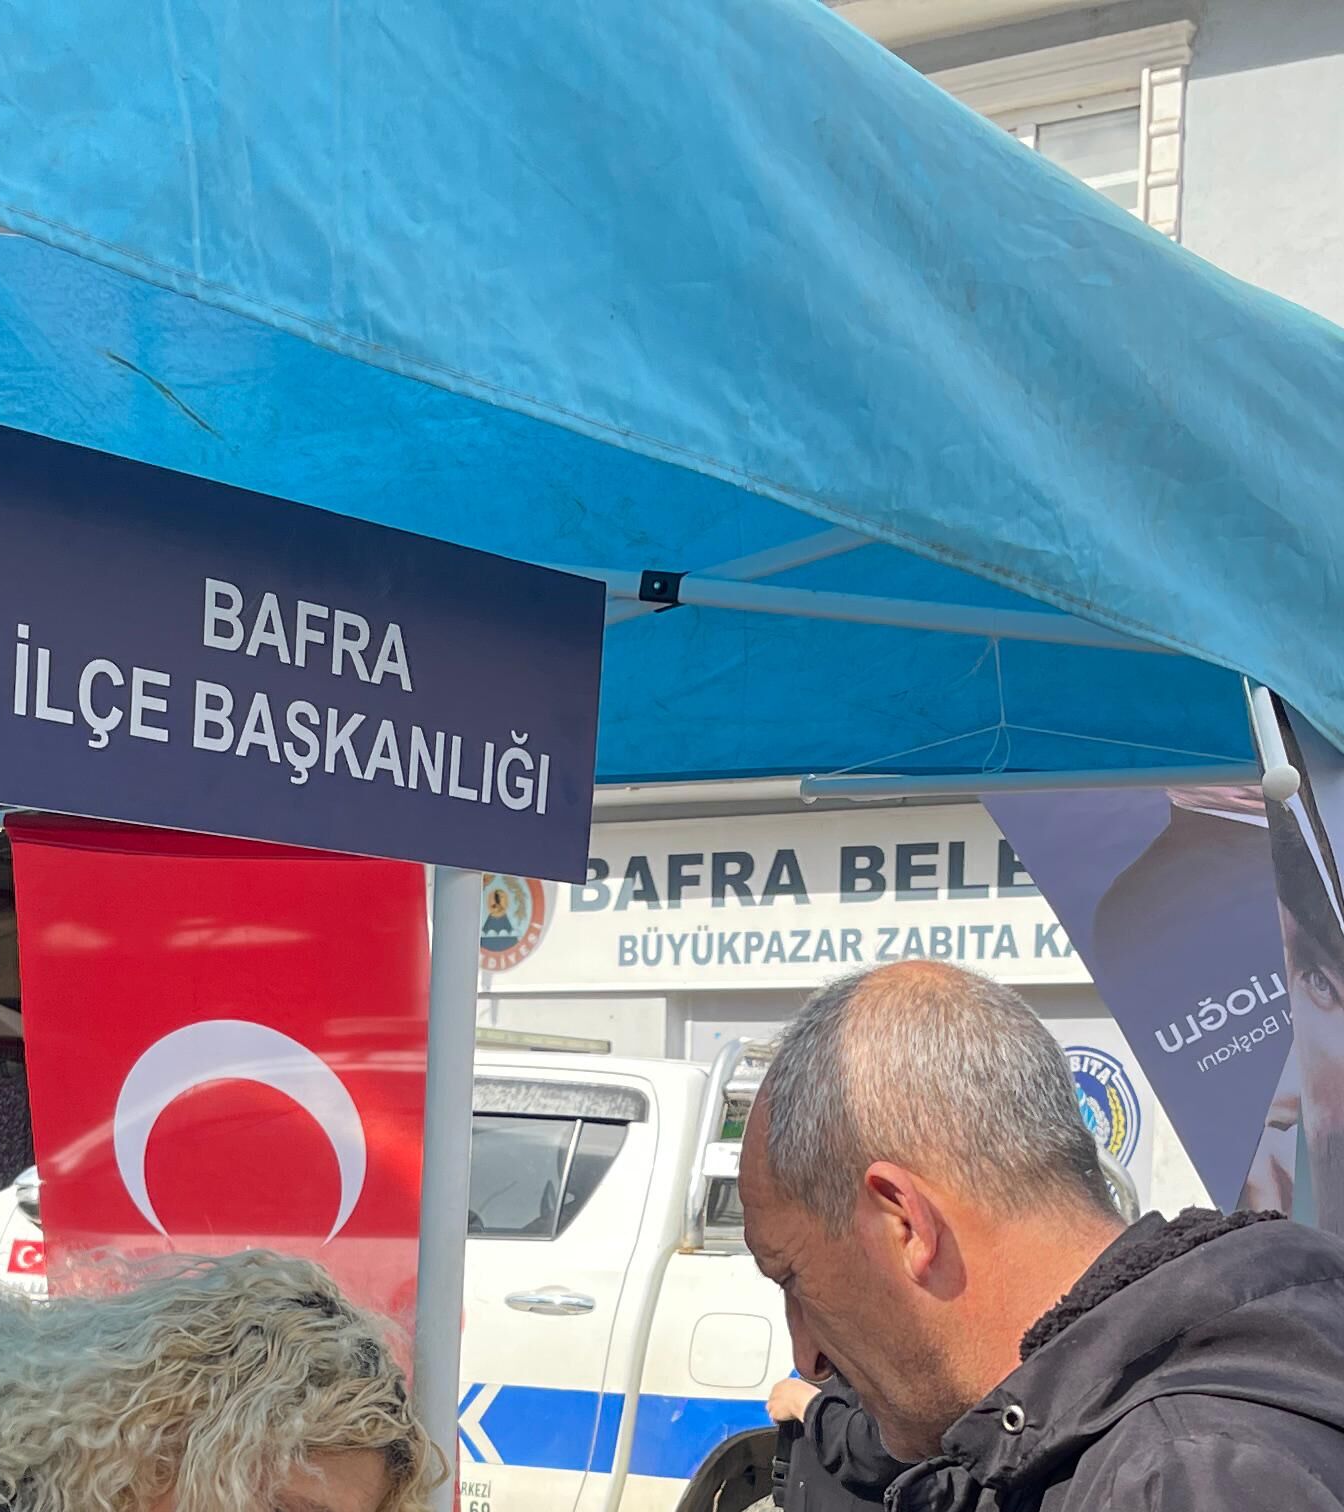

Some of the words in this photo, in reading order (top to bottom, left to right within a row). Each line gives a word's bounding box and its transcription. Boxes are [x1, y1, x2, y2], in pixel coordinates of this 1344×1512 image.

[204, 578, 412, 691] BAFRA
[14, 623, 169, 749] İLÇE
[193, 680, 550, 815] BAŞKANLIĞI
[570, 848, 808, 912] BAFRA
[618, 925, 862, 968] BÜYÜKPAZAR
[875, 923, 1019, 962] ZABITA
